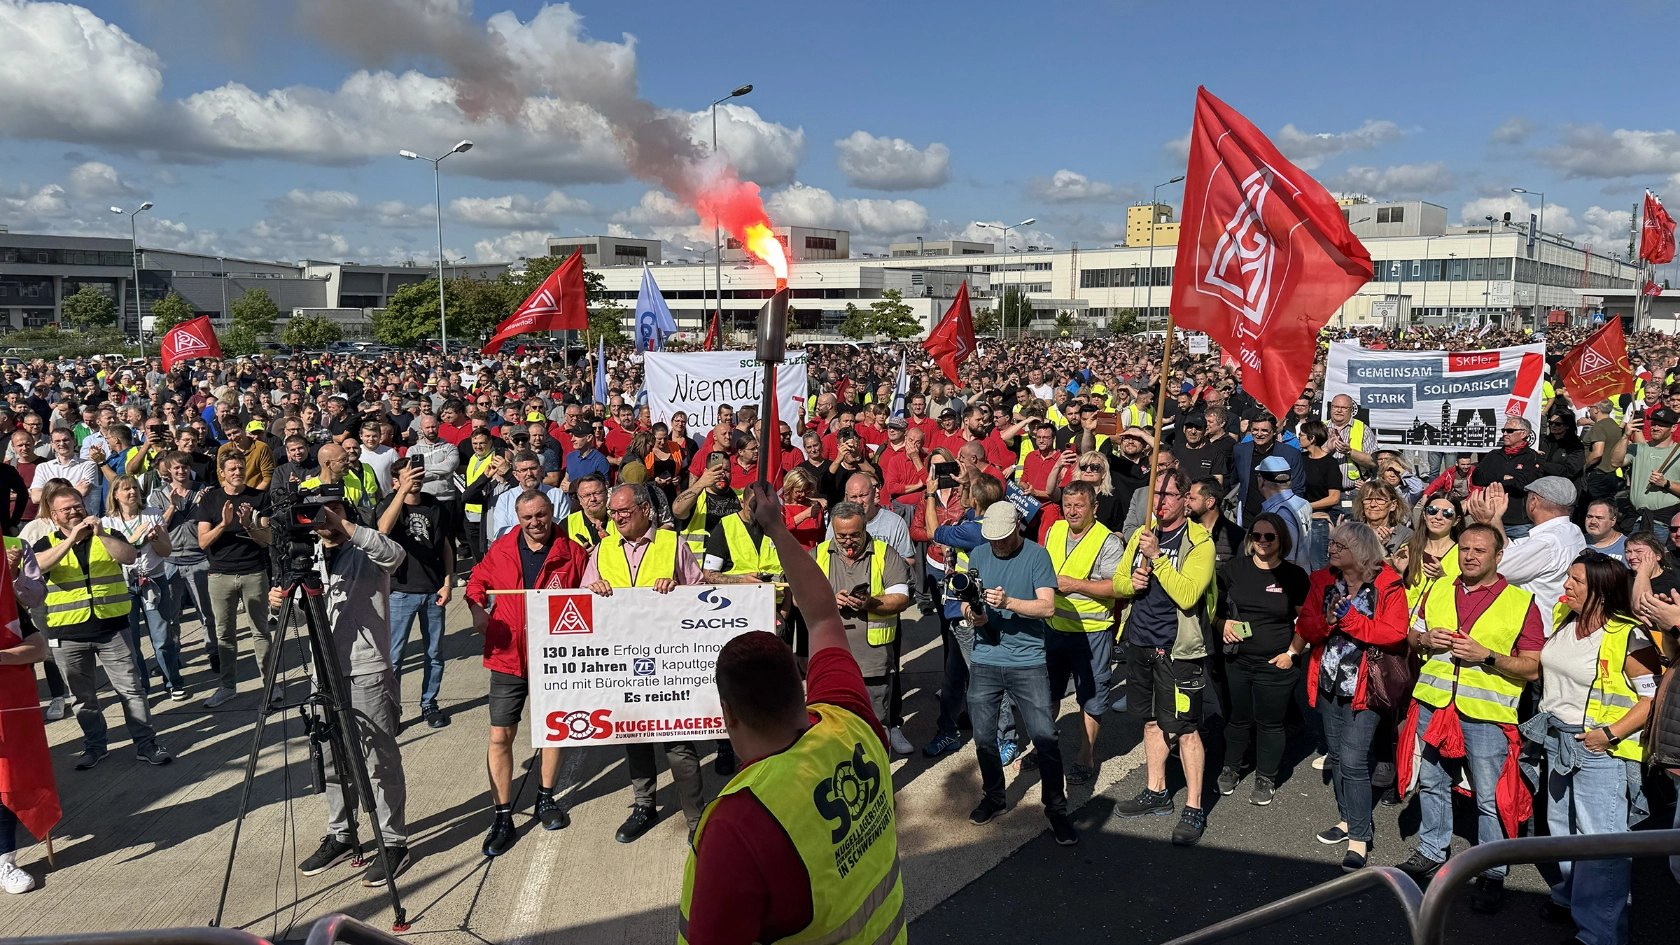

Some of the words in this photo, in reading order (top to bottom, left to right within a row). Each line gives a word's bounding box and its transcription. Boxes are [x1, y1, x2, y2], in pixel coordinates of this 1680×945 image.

[1357, 367, 1432, 378] GEMEINSAM
[669, 371, 765, 403] Niemal
[1424, 379, 1509, 395] SOLIDARISCH
[1367, 393, 1406, 404] STARK
[688, 405, 719, 428] all
[681, 617, 749, 630] SACHS
[543, 647, 567, 658] 130
[572, 646, 609, 657] Jahre
[614, 645, 650, 657] Erfolg
[654, 643, 689, 654] durch
[544, 664, 557, 674] In
[562, 662, 576, 673] 10
[581, 662, 627, 673] Jahren
[635, 661, 654, 673] ZF
[662, 659, 717, 671] kaputtge
[545, 680, 568, 690] und
[573, 679, 591, 689] mit
[595, 676, 660, 688] Bürokratie
[624, 692, 642, 703] Es
[645, 690, 690, 702] reicht!
[546, 709, 613, 742] SOS
[616, 717, 724, 733] KUGELLAGERS
[835, 789, 887, 860] KUGELLAGERSTADT
[838, 862, 850, 879] IN
